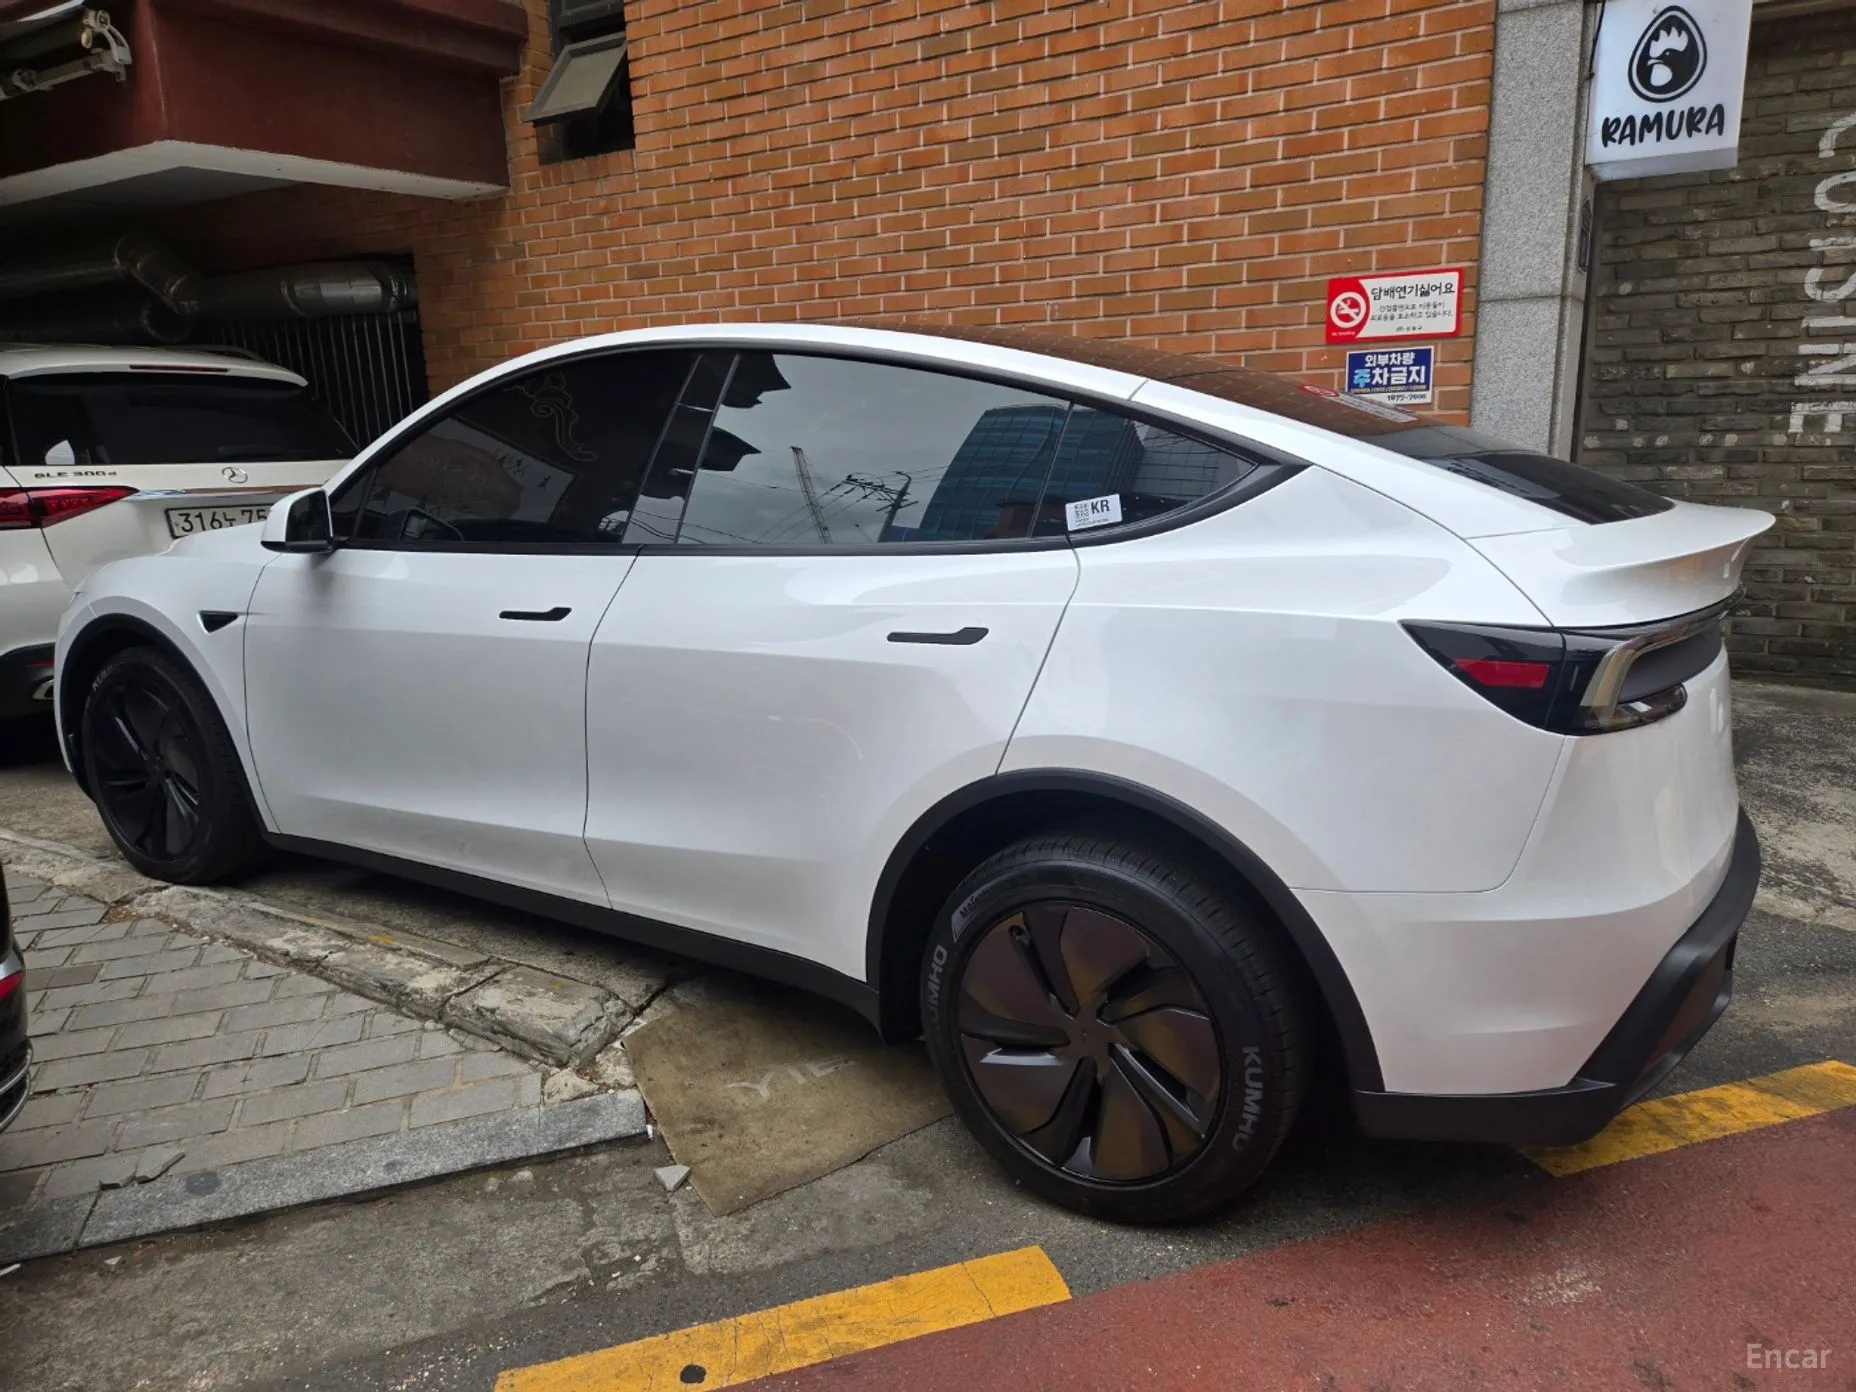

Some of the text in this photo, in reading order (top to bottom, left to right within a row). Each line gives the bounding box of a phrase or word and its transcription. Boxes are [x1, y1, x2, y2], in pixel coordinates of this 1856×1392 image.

[1601, 103, 1725, 148] RAMURA
[1371, 283, 1455, 300] 담배연기싫어요
[1364, 352, 1416, 367] 외부차량
[1354, 366, 1425, 387] 주차금지
[1091, 500, 1110, 514] KR
